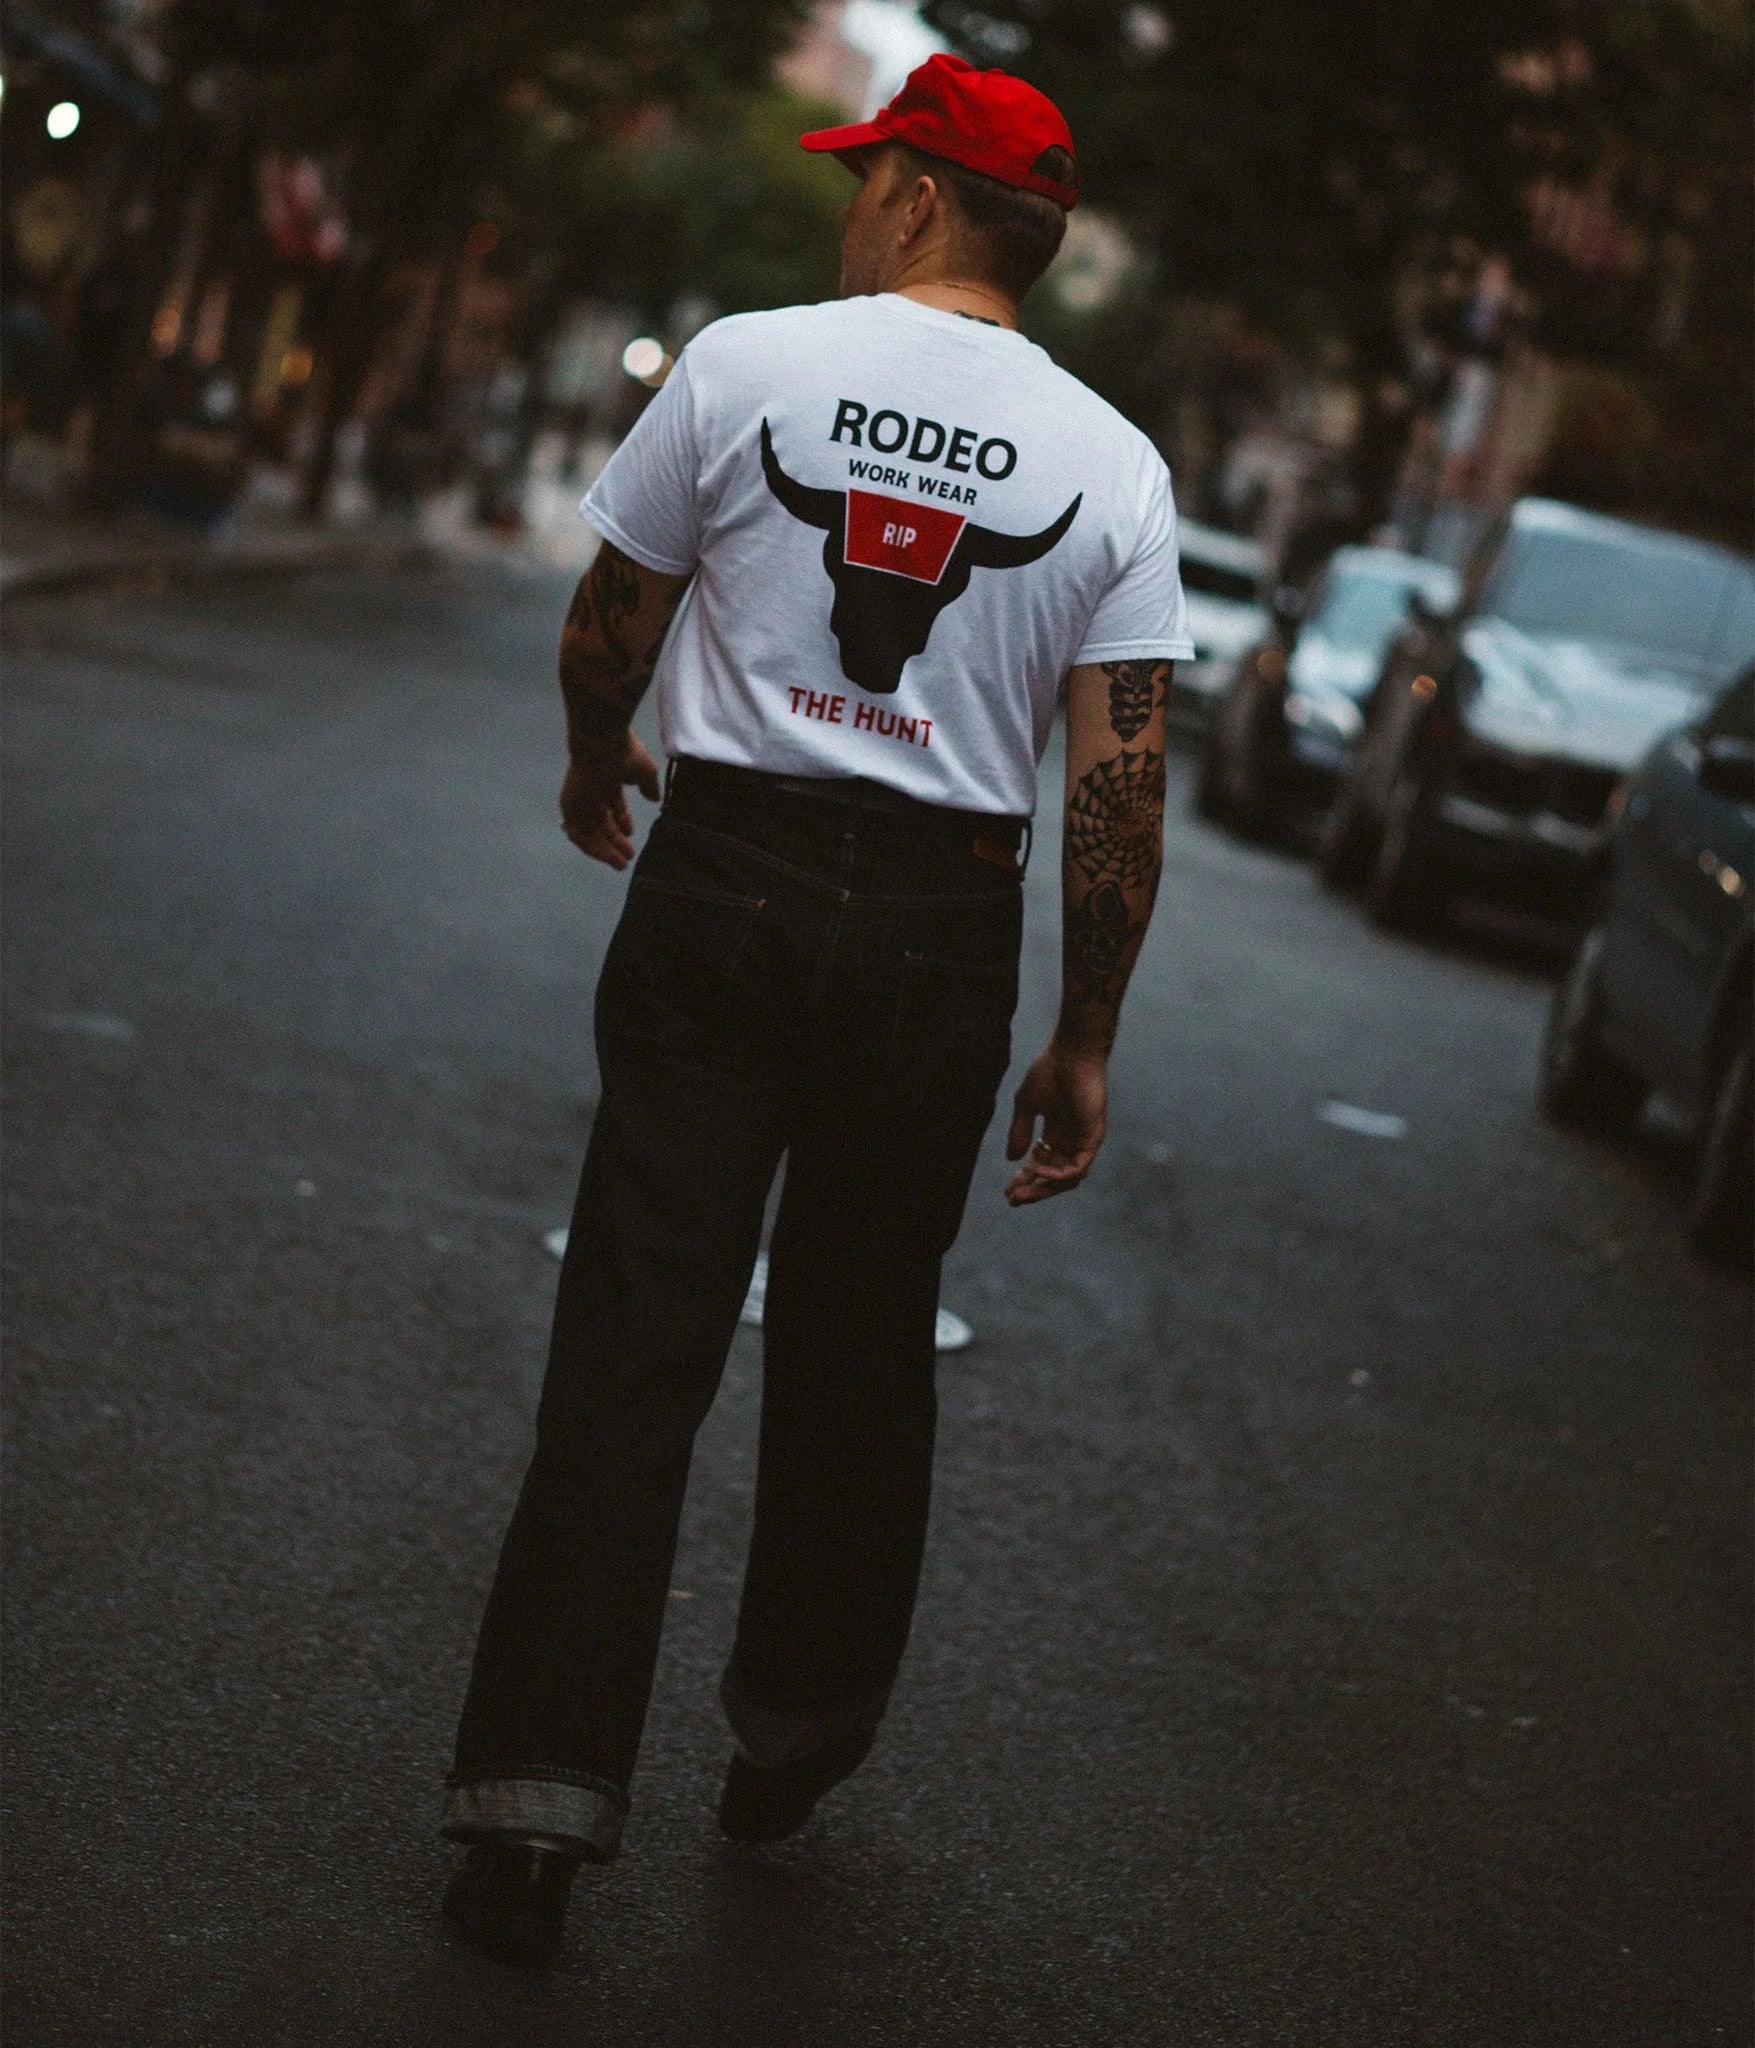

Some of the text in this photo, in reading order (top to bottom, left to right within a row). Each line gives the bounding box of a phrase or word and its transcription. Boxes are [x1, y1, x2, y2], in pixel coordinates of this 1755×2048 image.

[829, 399, 1018, 481] RODEO
[848, 458, 977, 506] WORK WEAR
[882, 522, 917, 549] RIP
[788, 686, 933, 748] THE HUNT
